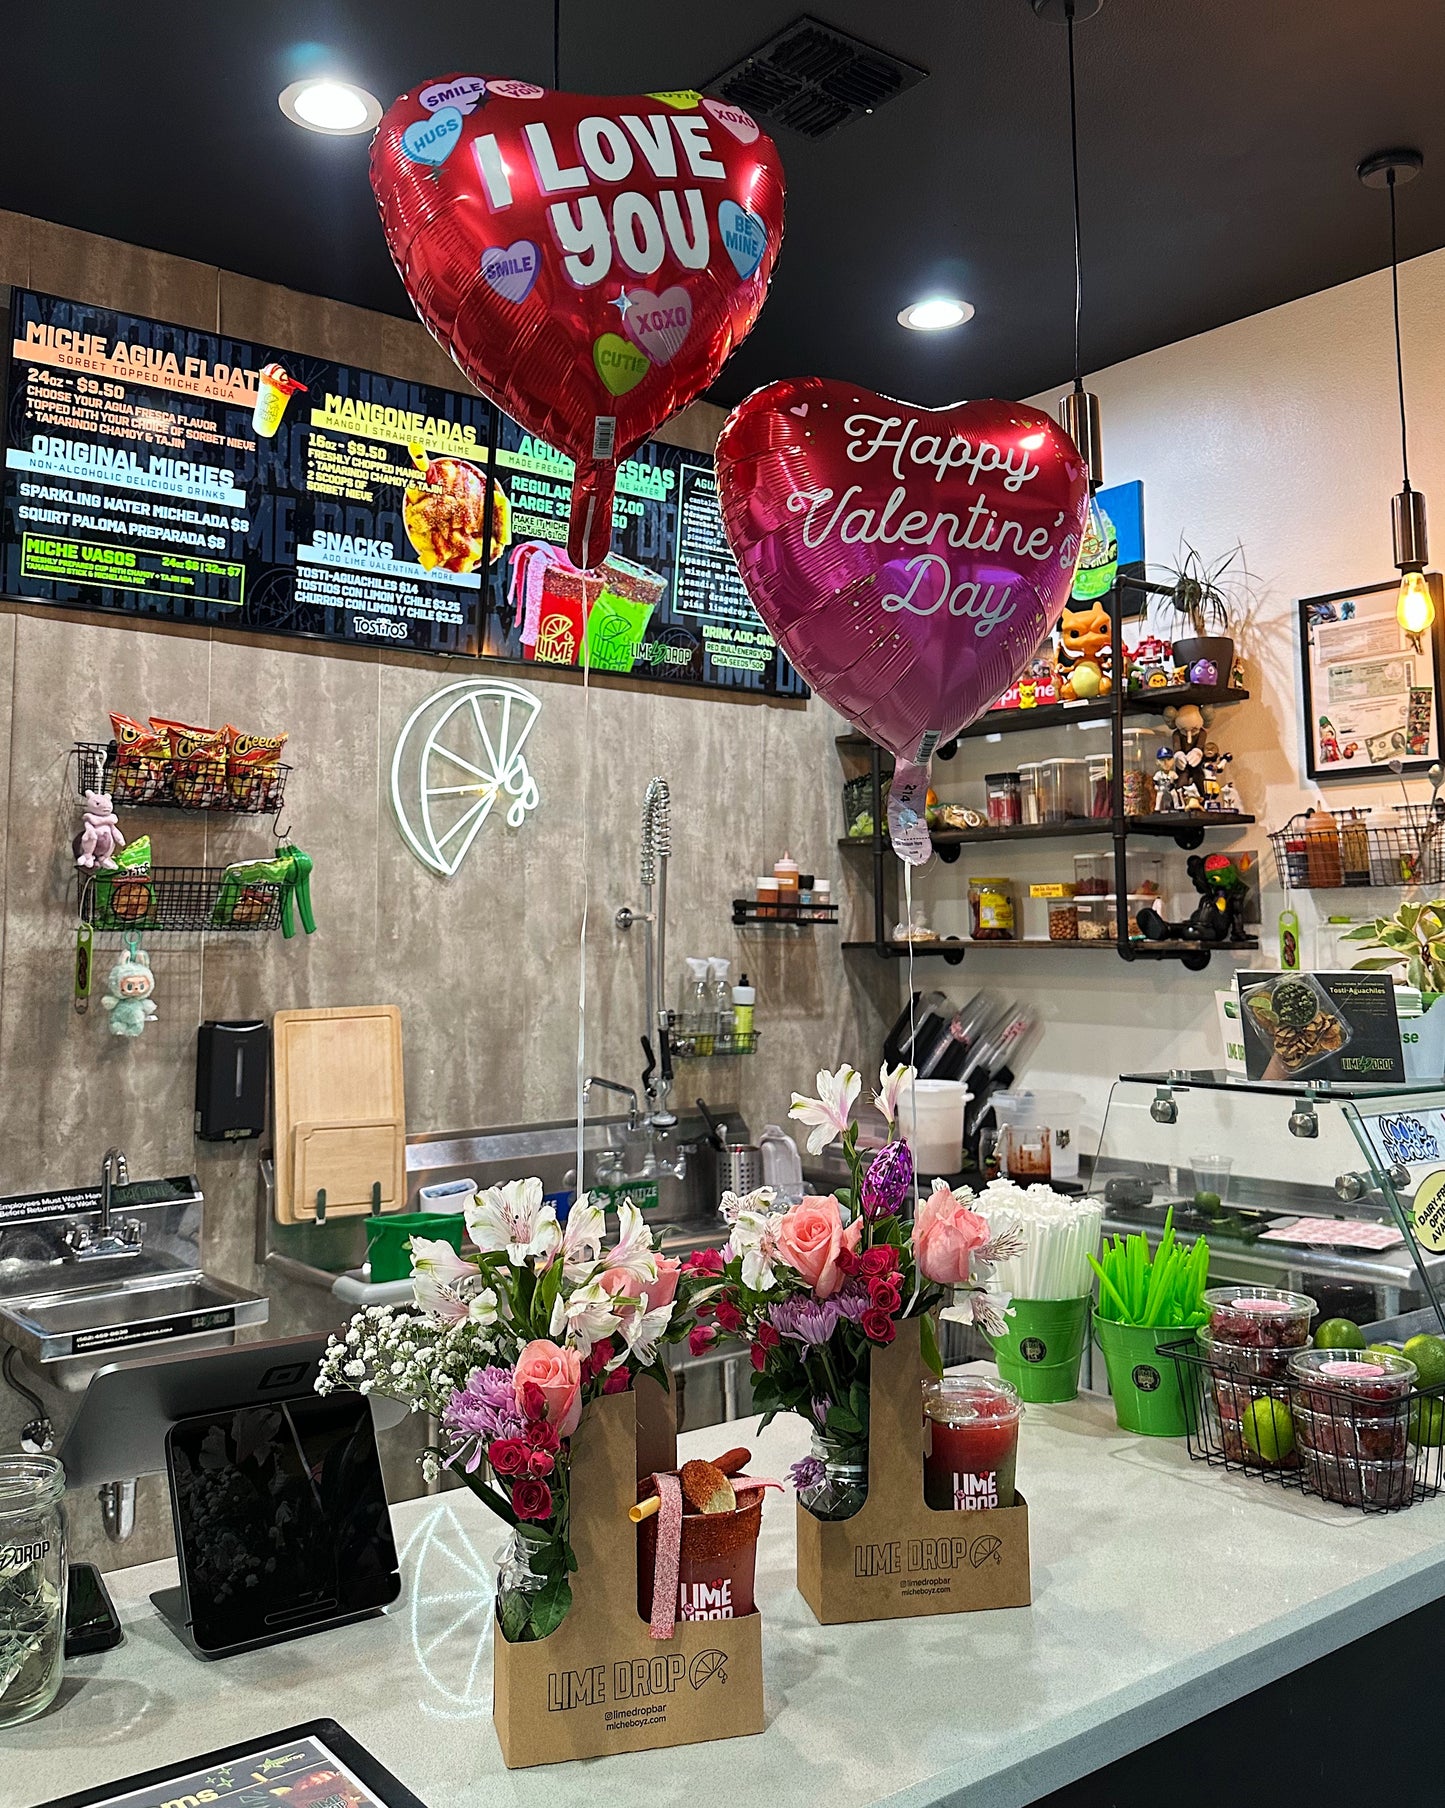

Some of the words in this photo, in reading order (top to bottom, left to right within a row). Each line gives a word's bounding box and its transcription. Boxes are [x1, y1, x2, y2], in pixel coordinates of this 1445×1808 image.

[426, 81, 484, 108] SMILE
[507, 86, 541, 98] YOU
[714, 108, 755, 130] XOXO
[413, 117, 460, 154] HUGS
[473, 133, 514, 211] I
[523, 114, 727, 194] LOVE
[548, 188, 711, 287] YOU
[734, 213, 754, 235] BE
[725, 231, 761, 258] MINE
[486, 254, 534, 281] SMILE
[637, 306, 688, 335] XOXO
[26, 321, 107, 356] MICHE
[106, 341, 181, 377] AGUA
[184, 355, 260, 392] FLOAT
[600, 349, 646, 373] CUTIE
[58, 353, 106, 372] SORBET
[112, 364, 159, 383] TOPPED
[164, 376, 200, 392] MICHE
[204, 385, 235, 399] AGUA
[76, 376, 125, 400] $9.50
[27, 385, 72, 403] CHOOSE
[73, 393, 104, 409] YOUR
[104, 400, 134, 416] AGUA
[134, 406, 176, 424] FRESCA
[177, 414, 217, 432] FLAVOR
[325, 392, 477, 445] MANGONEADAS
[26, 397, 71, 415] TOPPED
[71, 406, 99, 421] WITH
[100, 411, 130, 427] YOUR
[131, 417, 169, 435] CHOICE
[170, 426, 185, 438] OF
[185, 429, 226, 446] SORBET
[226, 436, 257, 452] NIEVE
[35, 411, 98, 433] TAMARINDO
[98, 423, 145, 442] CHAMOY
[154, 434, 186, 450] TAJIN
[326, 416, 361, 432] MANGO
[372, 426, 438, 448] STRAWBERRY
[448, 441, 470, 456] LIME
[32, 434, 144, 473] ORIGINAL
[150, 455, 235, 489] MICHES
[308, 447, 351, 465] FRESHLY
[351, 456, 395, 475] CHOPPED
[395, 465, 427, 481] MANGO
[347, 440, 387, 461] $9.50
[844, 413, 1040, 493] Happy
[29, 458, 122, 482] NON-ALCOHOLIC
[126, 475, 183, 493] DELICIOUS
[187, 486, 226, 500] DRINKS
[306, 470, 315, 480] 2
[315, 471, 354, 488] SCOOPS
[354, 479, 368, 490] OF
[315, 460, 369, 481] TAMARINDO
[370, 471, 408, 488] CHAMOY
[417, 481, 443, 495] TAJIN
[508, 456, 533, 469] MADE
[535, 462, 568, 476] FRESH
[633, 484, 660, 497] WATER
[511, 475, 571, 501] REGULAR
[306, 480, 345, 497] SORBET
[345, 487, 374, 503] NIEVE
[510, 493, 554, 515] LARGE
[19, 482, 102, 508] SPARKLING
[104, 496, 151, 517] WATER
[152, 504, 229, 530] MICHELADA
[231, 516, 250, 533] $8
[18, 505, 71, 526] SQUIRT
[72, 513, 127, 536] PALOMA
[128, 522, 206, 548] PREPARADA
[207, 534, 226, 551] $8
[512, 524, 528, 535] FOR
[528, 526, 547, 539] JUST
[547, 529, 568, 543] $1.00
[513, 512, 536, 526] MAKE
[536, 518, 545, 530] IT
[545, 519, 569, 532] MICHE
[786, 485, 1076, 570] Valentine's
[27, 538, 79, 559] MICHE
[81, 546, 136, 567] VASOS
[312, 529, 394, 561] SNACKS
[322, 552, 339, 563] ADD
[344, 557, 366, 568] LIME
[369, 560, 419, 576] VALENTINA
[431, 571, 454, 582] MORE
[685, 556, 722, 570] passion
[685, 567, 712, 579] mixed
[296, 566, 398, 592] TOSTI-AGUACHILES
[398, 581, 419, 595] $14
[684, 589, 705, 599] sour
[685, 578, 716, 590] sandia
[294, 591, 344, 608] CHURROS
[344, 598, 367, 612] CON
[367, 601, 397, 616] LIMON
[398, 605, 407, 617] Y
[406, 607, 435, 622] CHILE
[435, 611, 464, 625] $3.25
[341, 585, 364, 598] CON
[364, 588, 395, 603] LIMON
[395, 592, 404, 604] Y
[403, 593, 432, 609] CHILE
[432, 598, 461, 613] $3.25
[881, 553, 1018, 638] Day
[708, 602, 748, 618] limedrop
[535, 635, 575, 661] LIME
[591, 634, 632, 662] LIME
[702, 625, 734, 642] DRINK
[733, 630, 776, 647] ADD-ONS
[630, 642, 653, 661] LIME
[665, 646, 692, 665] DROP
[706, 643, 719, 652] RED
[720, 644, 736, 654] BULL
[737, 646, 761, 658] ENERGY
[712, 656, 728, 666] CHIA
[728, 658, 749, 669] SEEDS
[900, 784, 917, 803] 214
[1329, 986, 1386, 996] Tosti-Aguachiles
[0, 1207, 26, 1218] Before
[26, 1203, 66, 1215] Returning
[66, 1202, 76, 1211] To
[76, 1199, 98, 1209] Work
[41, 1196, 63, 1206] Must
[62, 1194, 85, 1203] Wash
[952, 1470, 998, 1496] LIME
[14, 1540, 50, 1565] DROP
[855, 1541, 901, 1578] LIME
[907, 1537, 968, 1572] DROP
[681, 1578, 732, 1608] LIME
[901, 1586, 951, 1597] micheboyz.com
[906, 1577, 951, 1588] limedropbar
[548, 1664, 606, 1712] LIME
[613, 1653, 686, 1701] DROP
[605, 1714, 667, 1731] micheboyz.com
[612, 1703, 667, 1721] limedropbar
